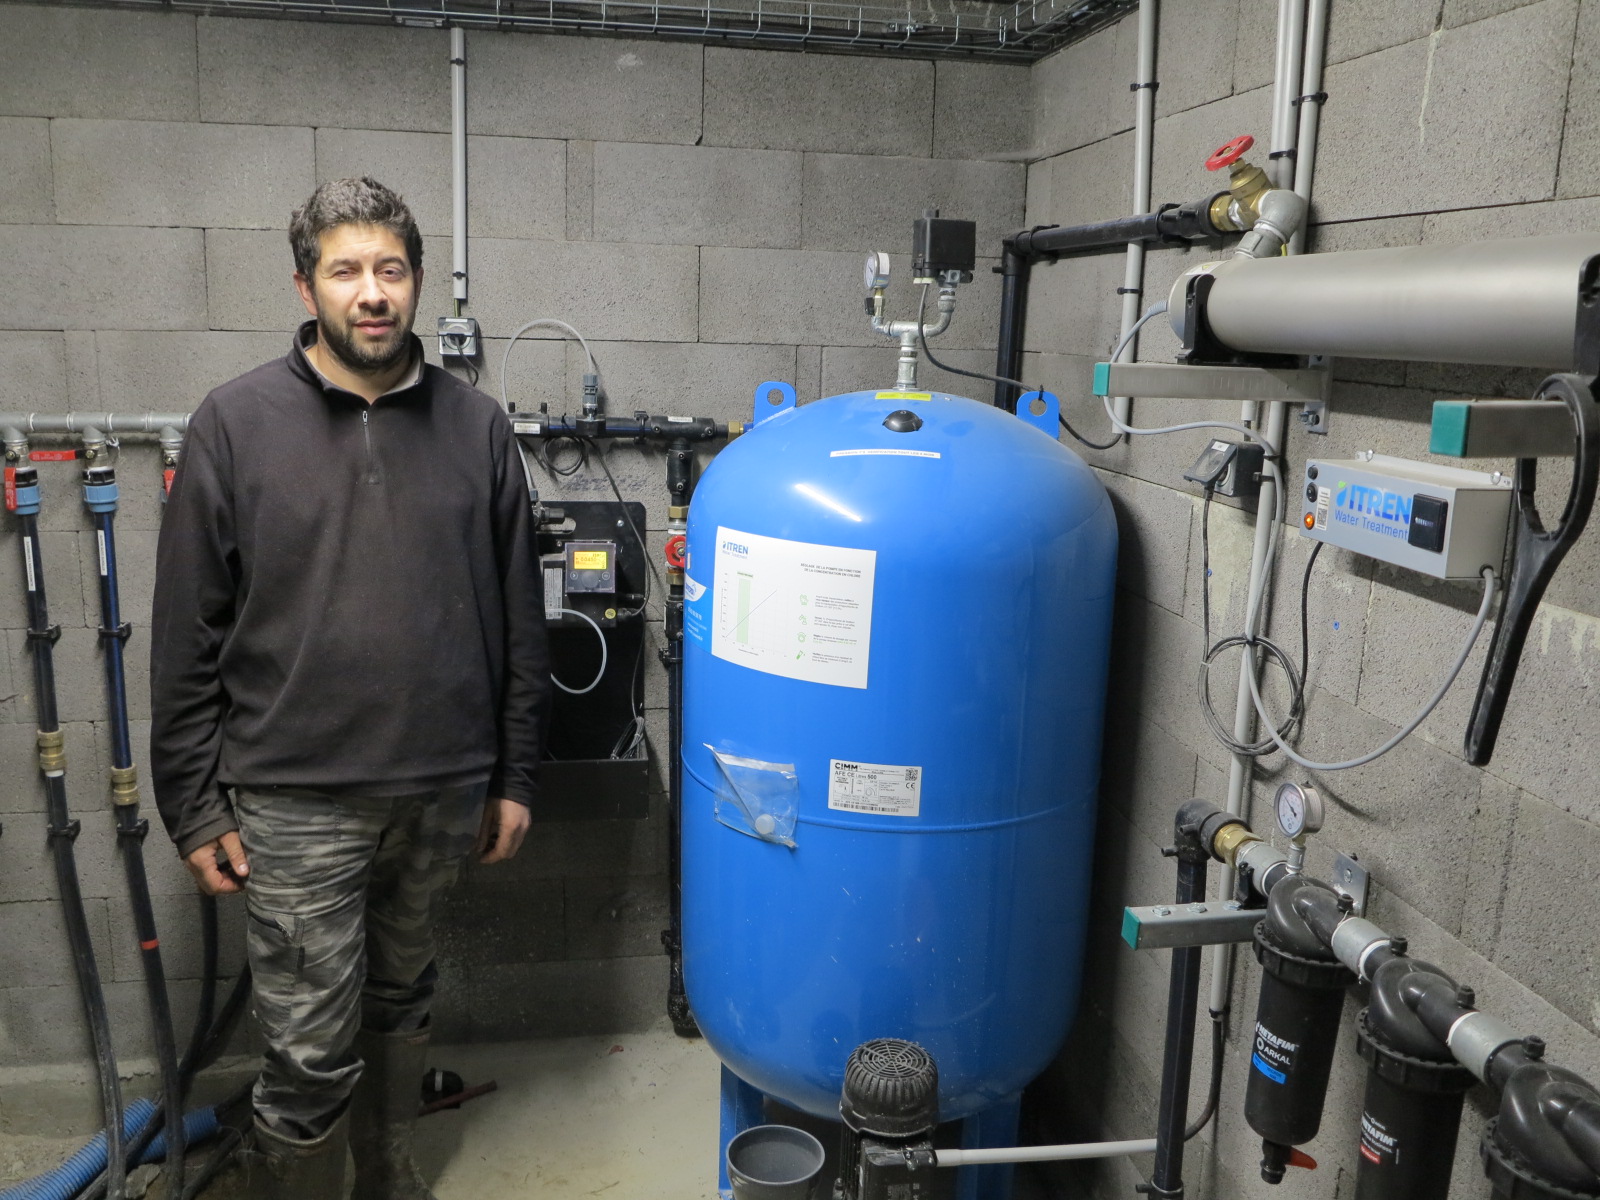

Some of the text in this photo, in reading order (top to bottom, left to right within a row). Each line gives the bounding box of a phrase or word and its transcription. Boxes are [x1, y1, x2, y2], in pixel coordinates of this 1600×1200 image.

[1349, 484, 1413, 524] ITREN
[1334, 509, 1359, 526] Water
[1361, 515, 1409, 540] Treatment
[726, 541, 749, 555] ITREN
[834, 762, 858, 770] CIMM
[1259, 1024, 1295, 1052] NETAFIM
[1263, 1046, 1291, 1065] ARKAL
